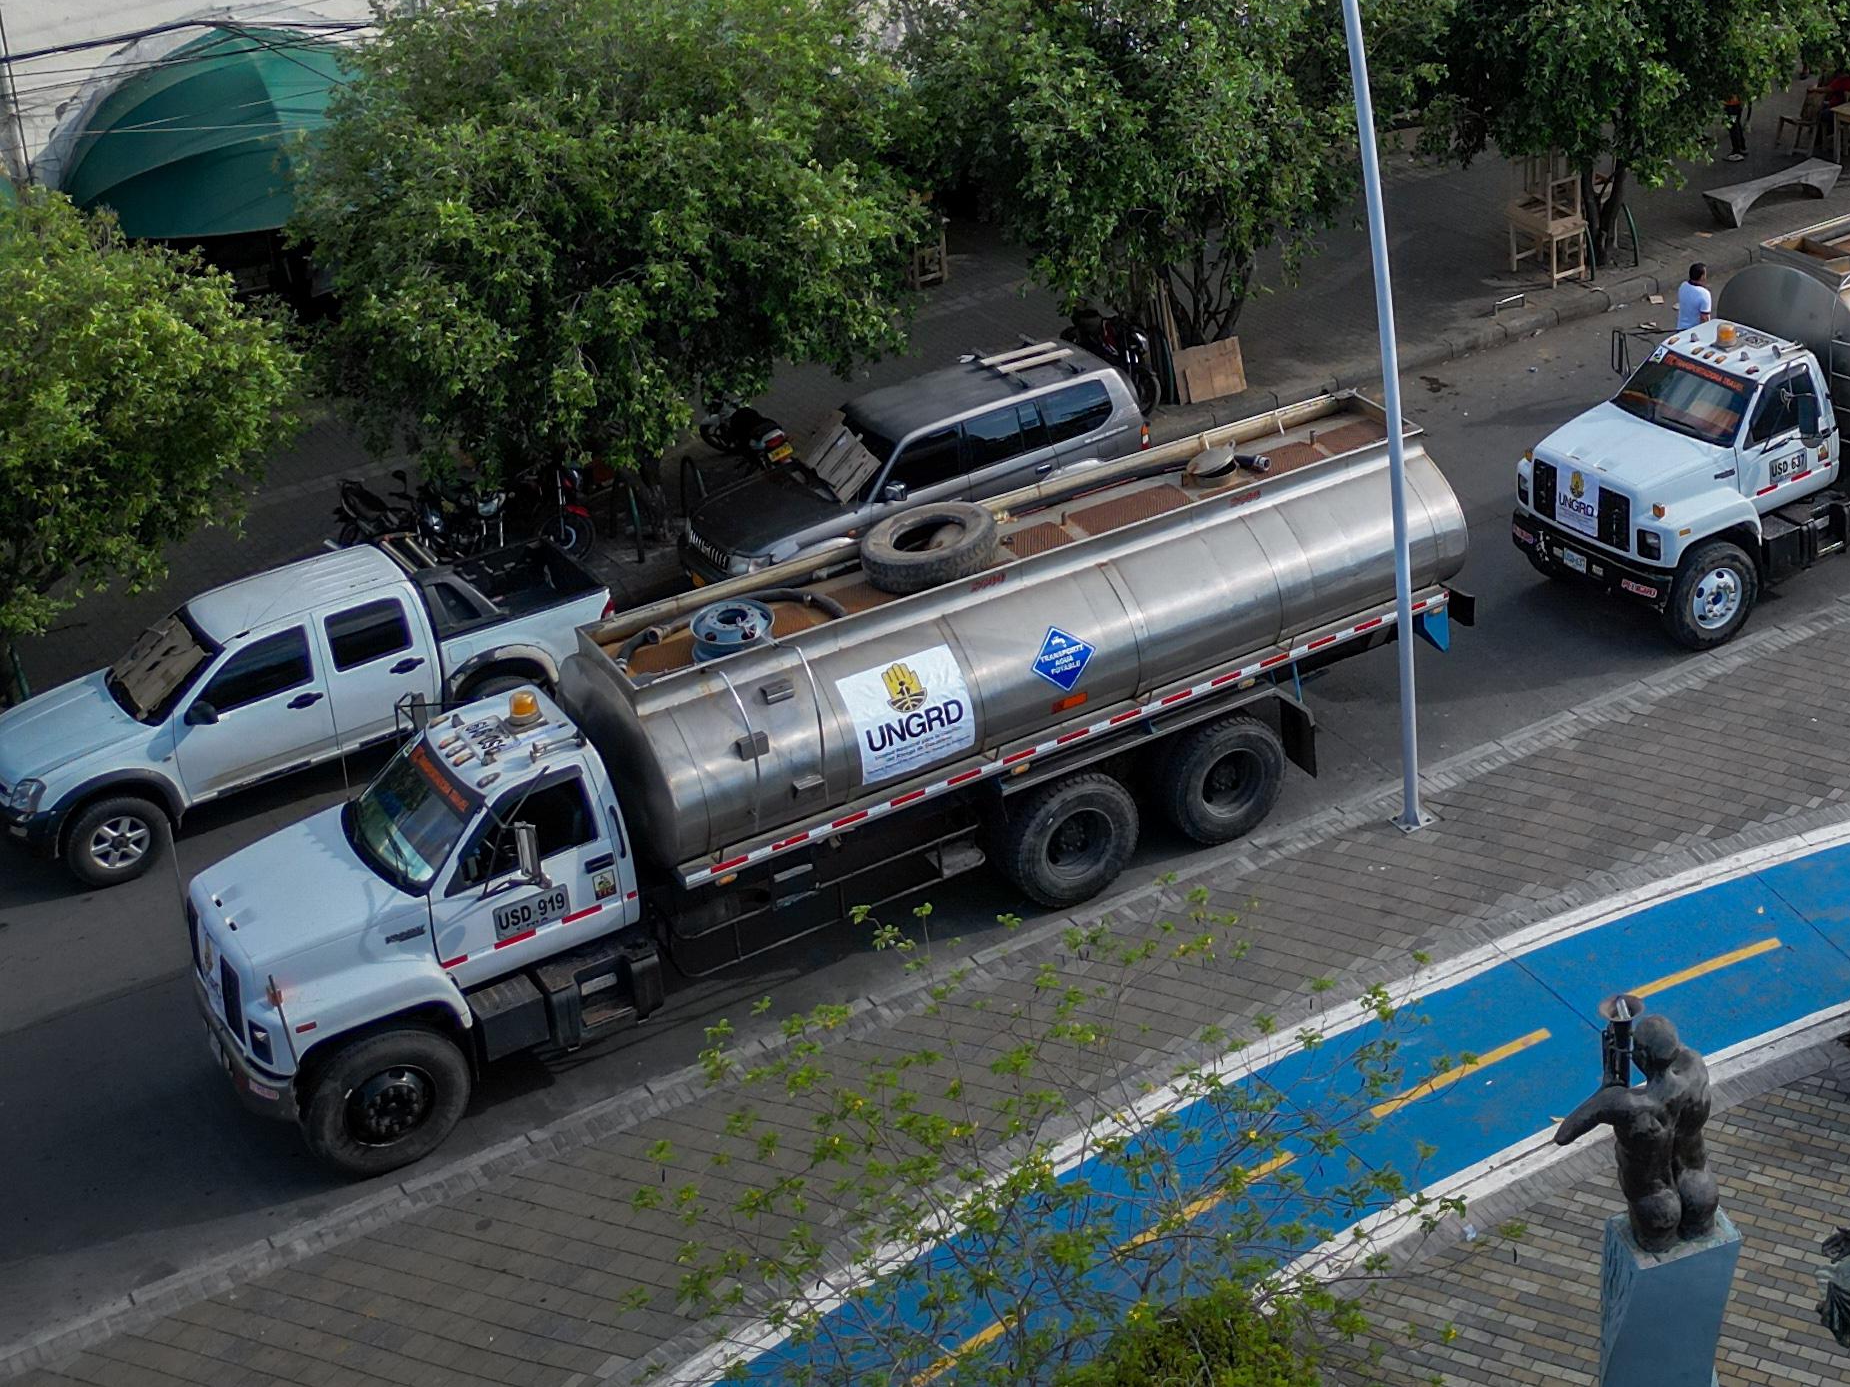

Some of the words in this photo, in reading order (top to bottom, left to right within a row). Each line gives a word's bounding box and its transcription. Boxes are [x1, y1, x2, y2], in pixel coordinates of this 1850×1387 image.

[1771, 460, 1788, 478] USD
[1791, 453, 1805, 470] 637
[1558, 492, 1595, 518] UNGRD
[865, 699, 964, 752] UNGRD
[498, 904, 532, 930] USD
[538, 892, 565, 916] 919
